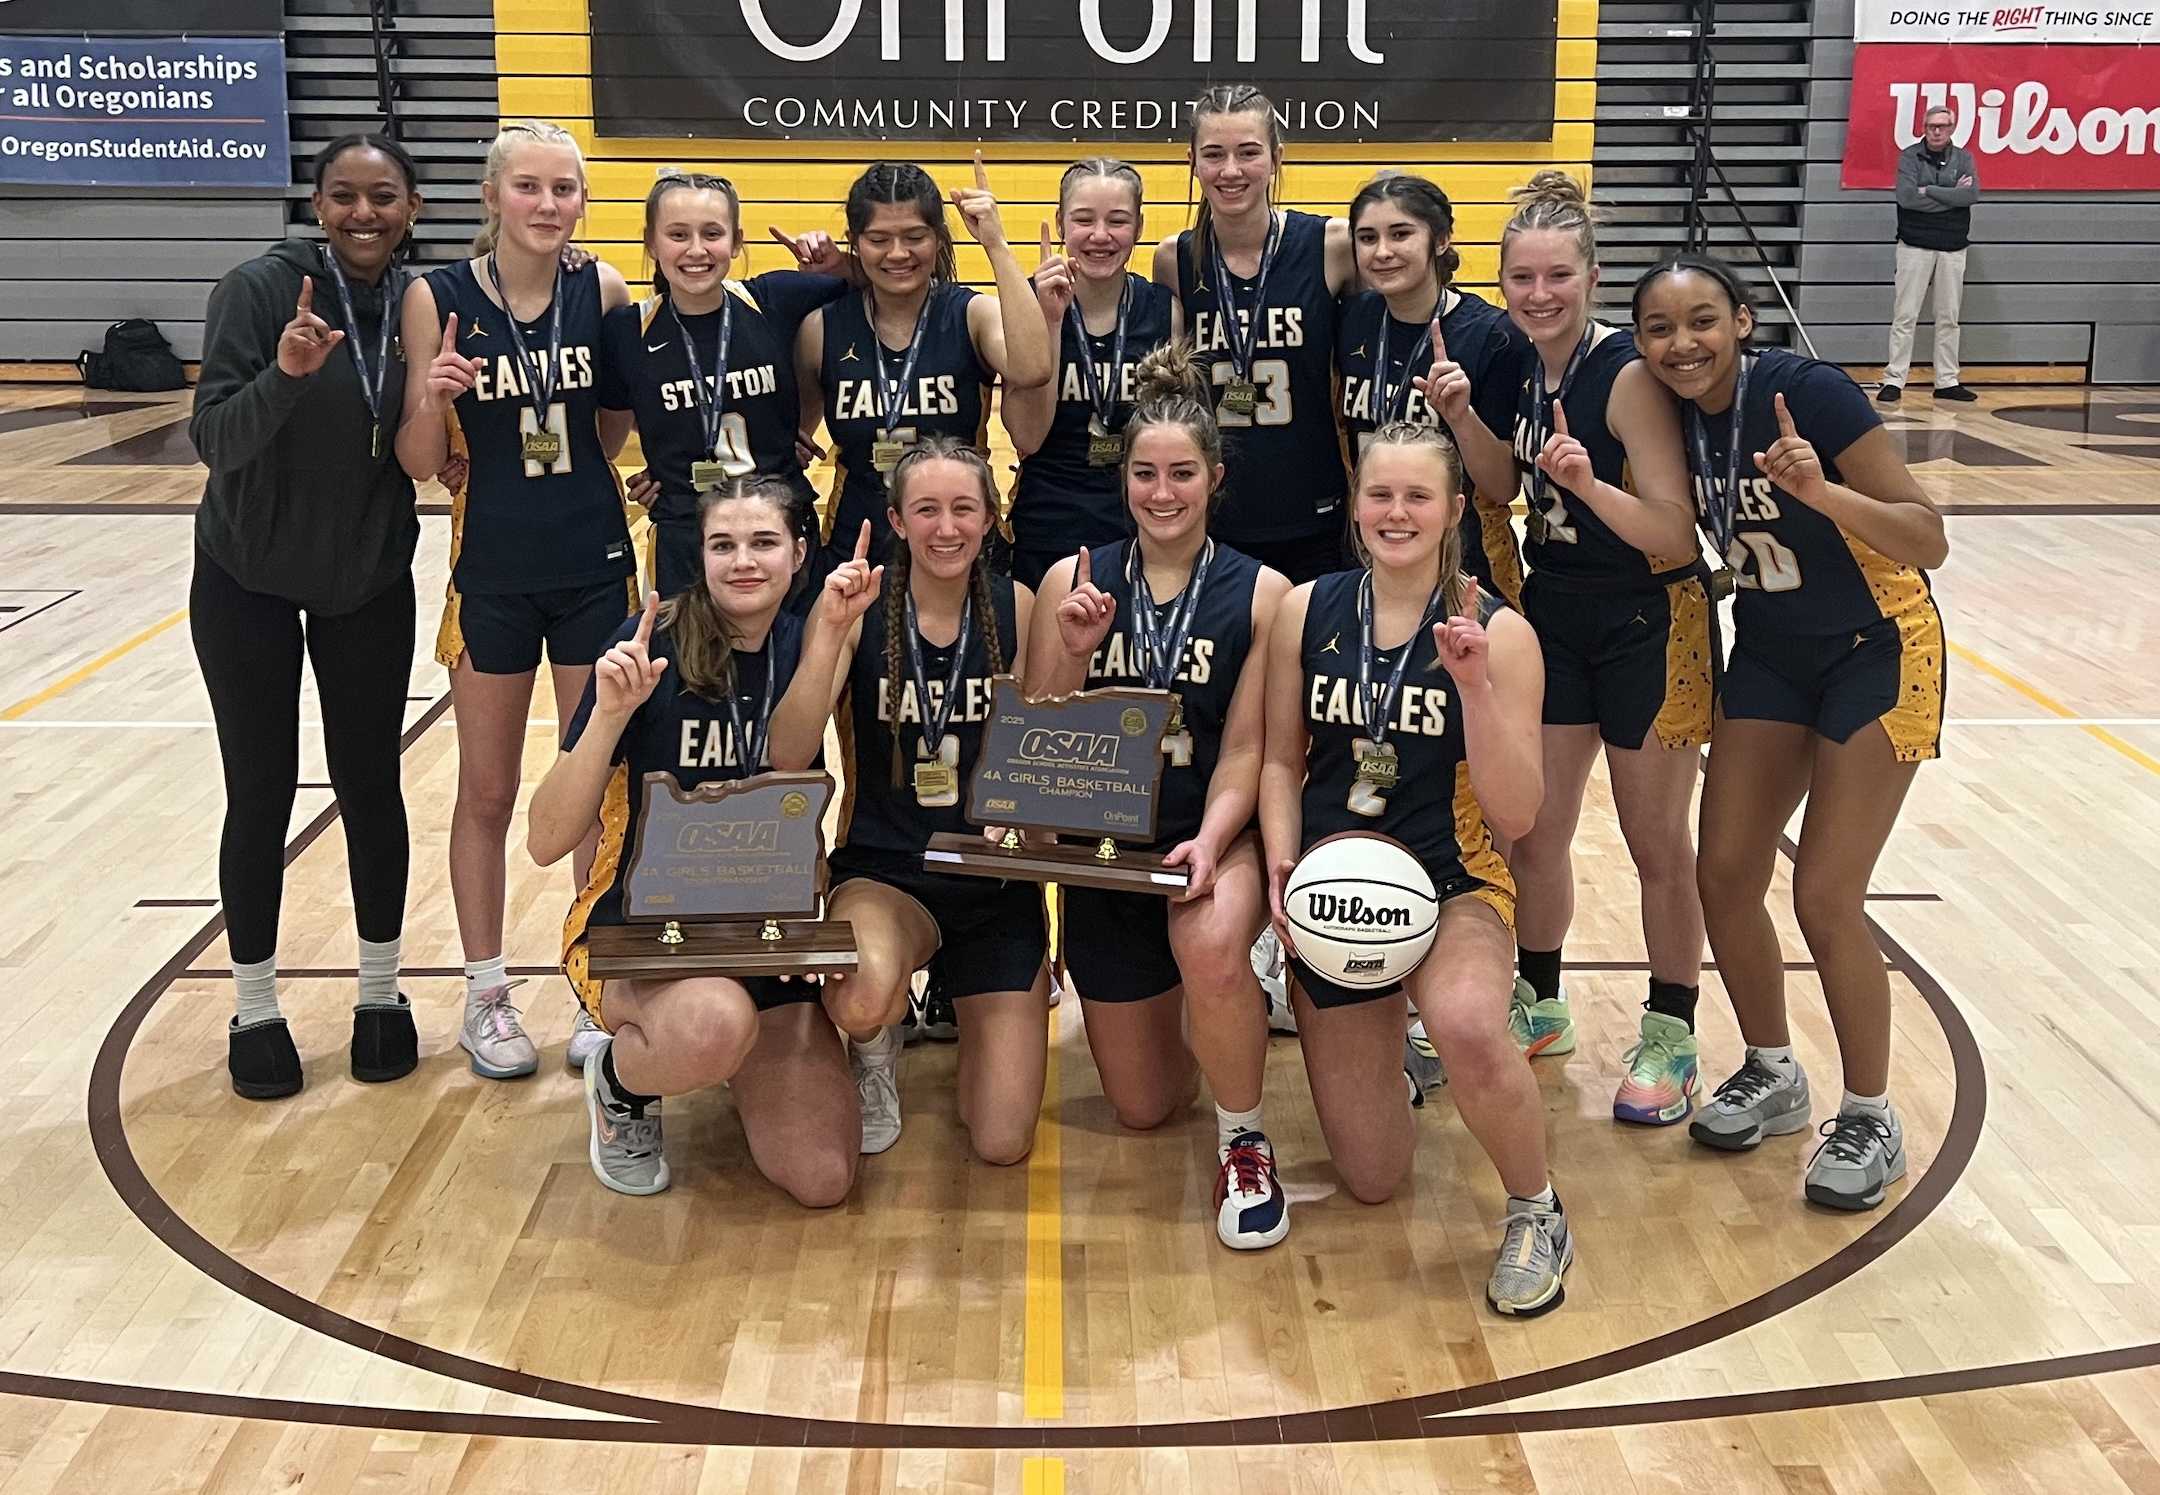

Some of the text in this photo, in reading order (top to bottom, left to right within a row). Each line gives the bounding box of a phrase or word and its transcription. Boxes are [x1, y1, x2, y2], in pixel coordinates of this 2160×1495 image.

[1889, 6, 2154, 27] DOING THE RIGHT THING SINCE
[20, 54, 72, 79] and
[79, 55, 258, 85] Scholarships
[12, 83, 50, 108] all
[56, 85, 214, 115] Oregonians
[743, 97, 1028, 129] COMMUNITY
[1273, 99, 1380, 130] NION
[1, 136, 267, 162] OregonStudentAid.Gov
[661, 364, 777, 412] STTON
[1211, 359, 1293, 427] 23
[1343, 376, 1440, 428] EAES
[1019, 728, 1120, 768] OSAA
[983, 770, 1151, 796] 4A GIRLS BASKETBALL
[1359, 760, 1397, 776] OSAA
[1308, 893, 1412, 926] Wilson
